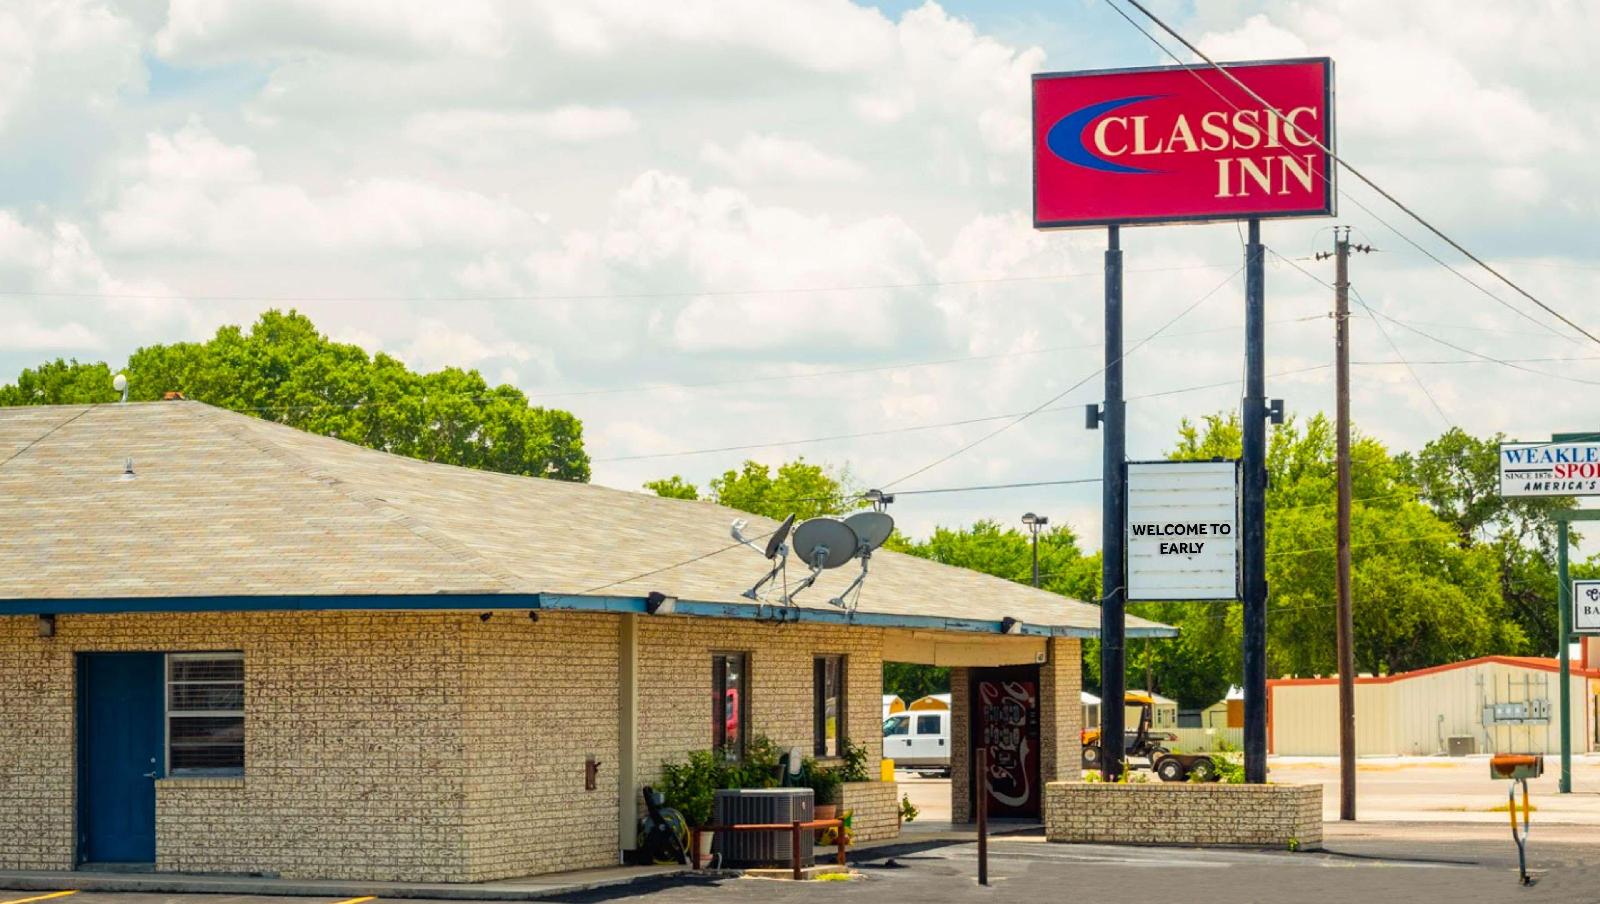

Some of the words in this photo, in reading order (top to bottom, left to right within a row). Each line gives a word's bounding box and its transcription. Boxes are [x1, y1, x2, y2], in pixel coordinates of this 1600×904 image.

[1094, 106, 1318, 156] CLASSIC
[1214, 154, 1317, 198] INN
[1524, 481, 1596, 491] AMERICA'S
[1132, 523, 1208, 536] WELCOME
[1210, 523, 1231, 535] TO
[1160, 542, 1204, 555] EARLY
